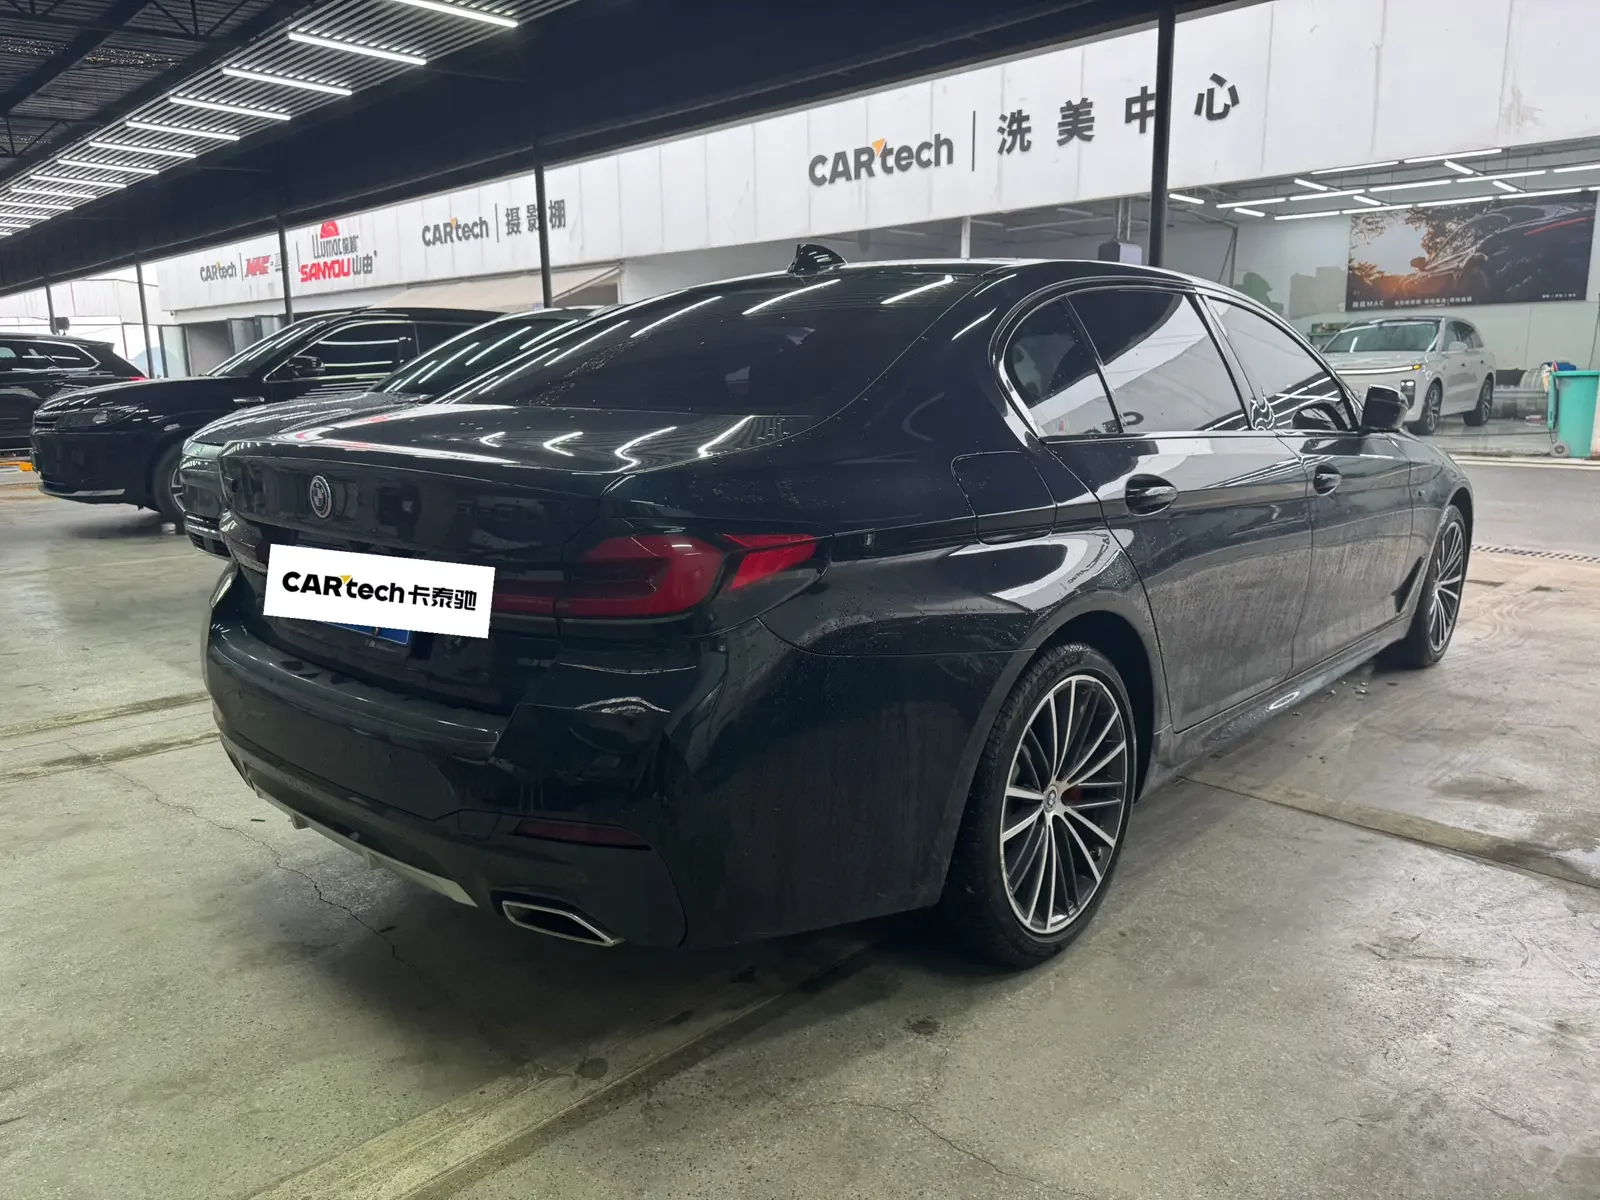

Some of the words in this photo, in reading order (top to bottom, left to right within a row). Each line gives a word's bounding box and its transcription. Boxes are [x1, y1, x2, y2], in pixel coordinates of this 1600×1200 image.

[808, 133, 954, 187] CARtech
[996, 72, 1241, 156] 洗美中心
[422, 216, 489, 247] CARtech
[505, 199, 566, 236] 摄影棚
[200, 261, 237, 282] CARtech
[300, 258, 351, 282] SANYOU
